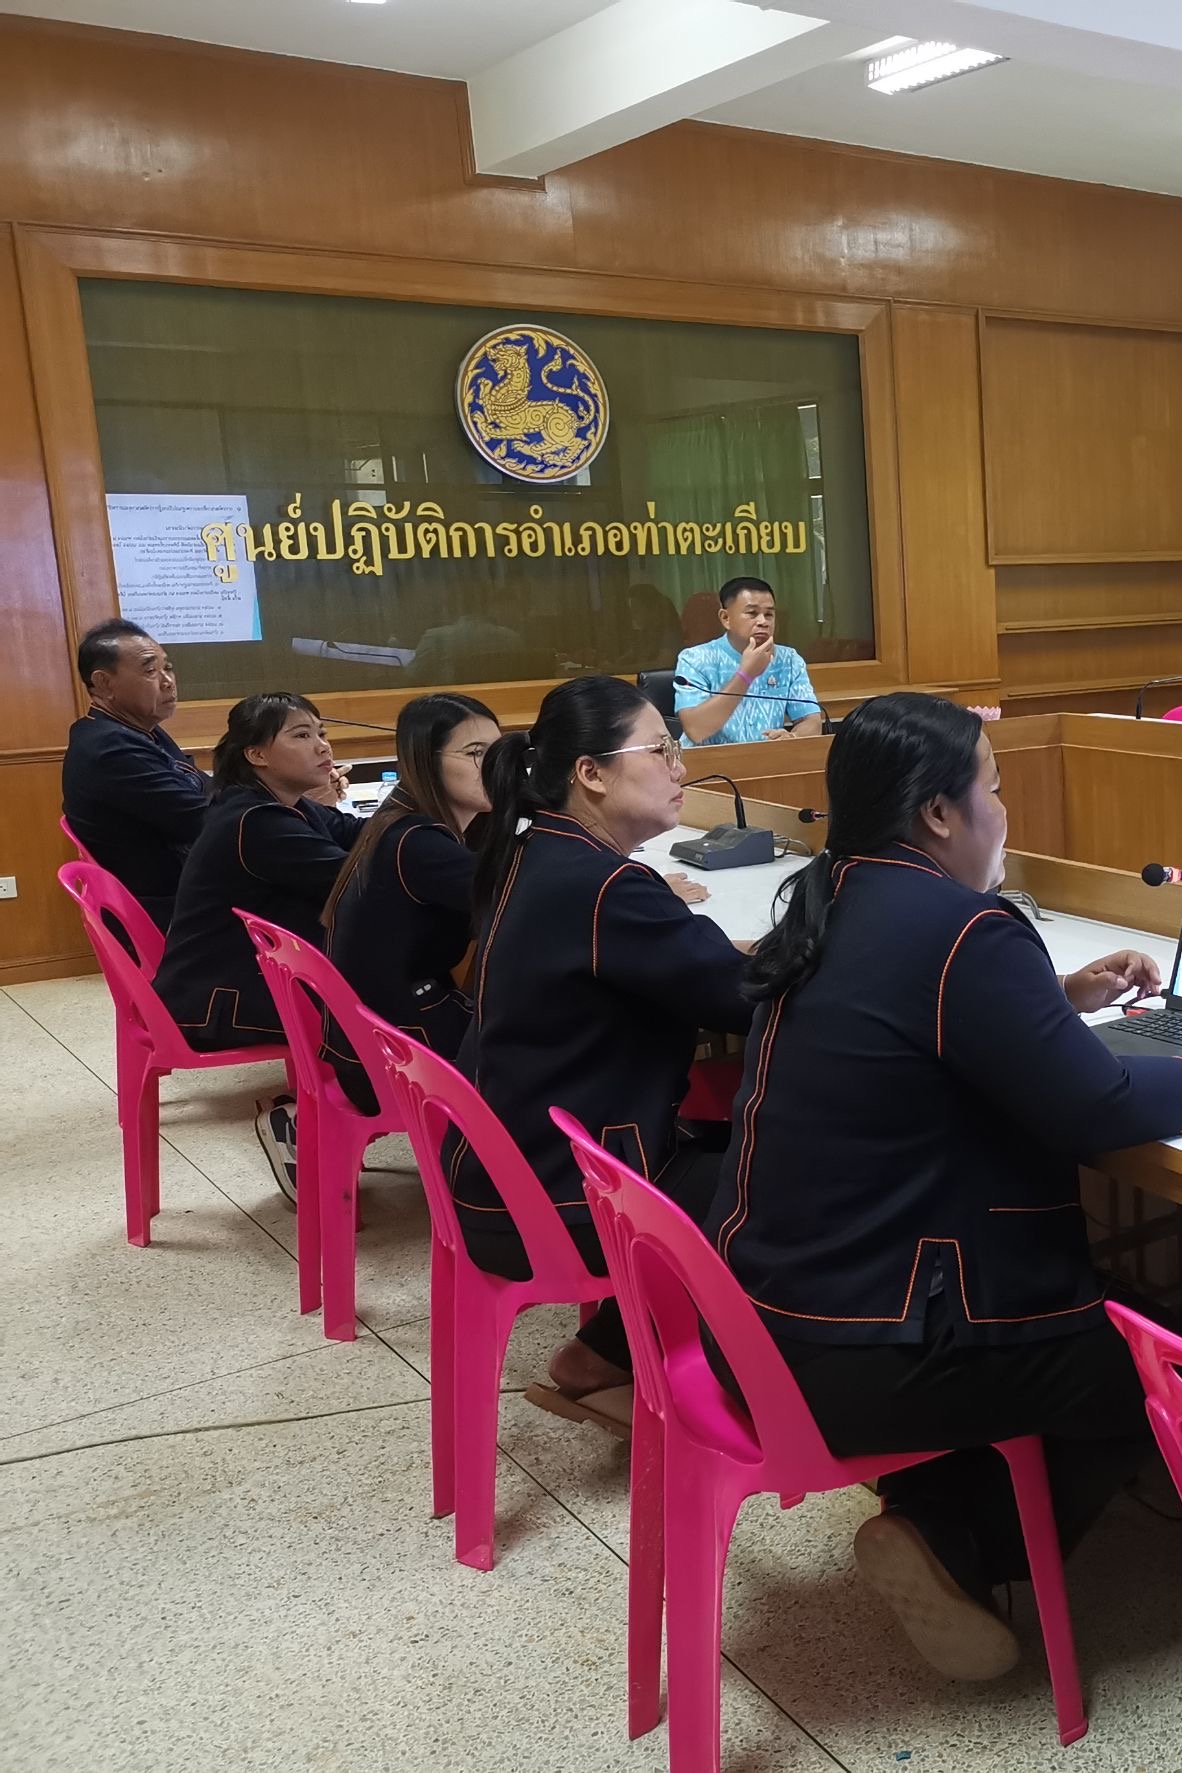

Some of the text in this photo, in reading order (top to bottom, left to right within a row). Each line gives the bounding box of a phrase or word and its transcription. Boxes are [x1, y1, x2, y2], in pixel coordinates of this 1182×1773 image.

[200, 492, 808, 584] ศูนย์ปฏิบัติการอำเภอท่าตะเกียบ
